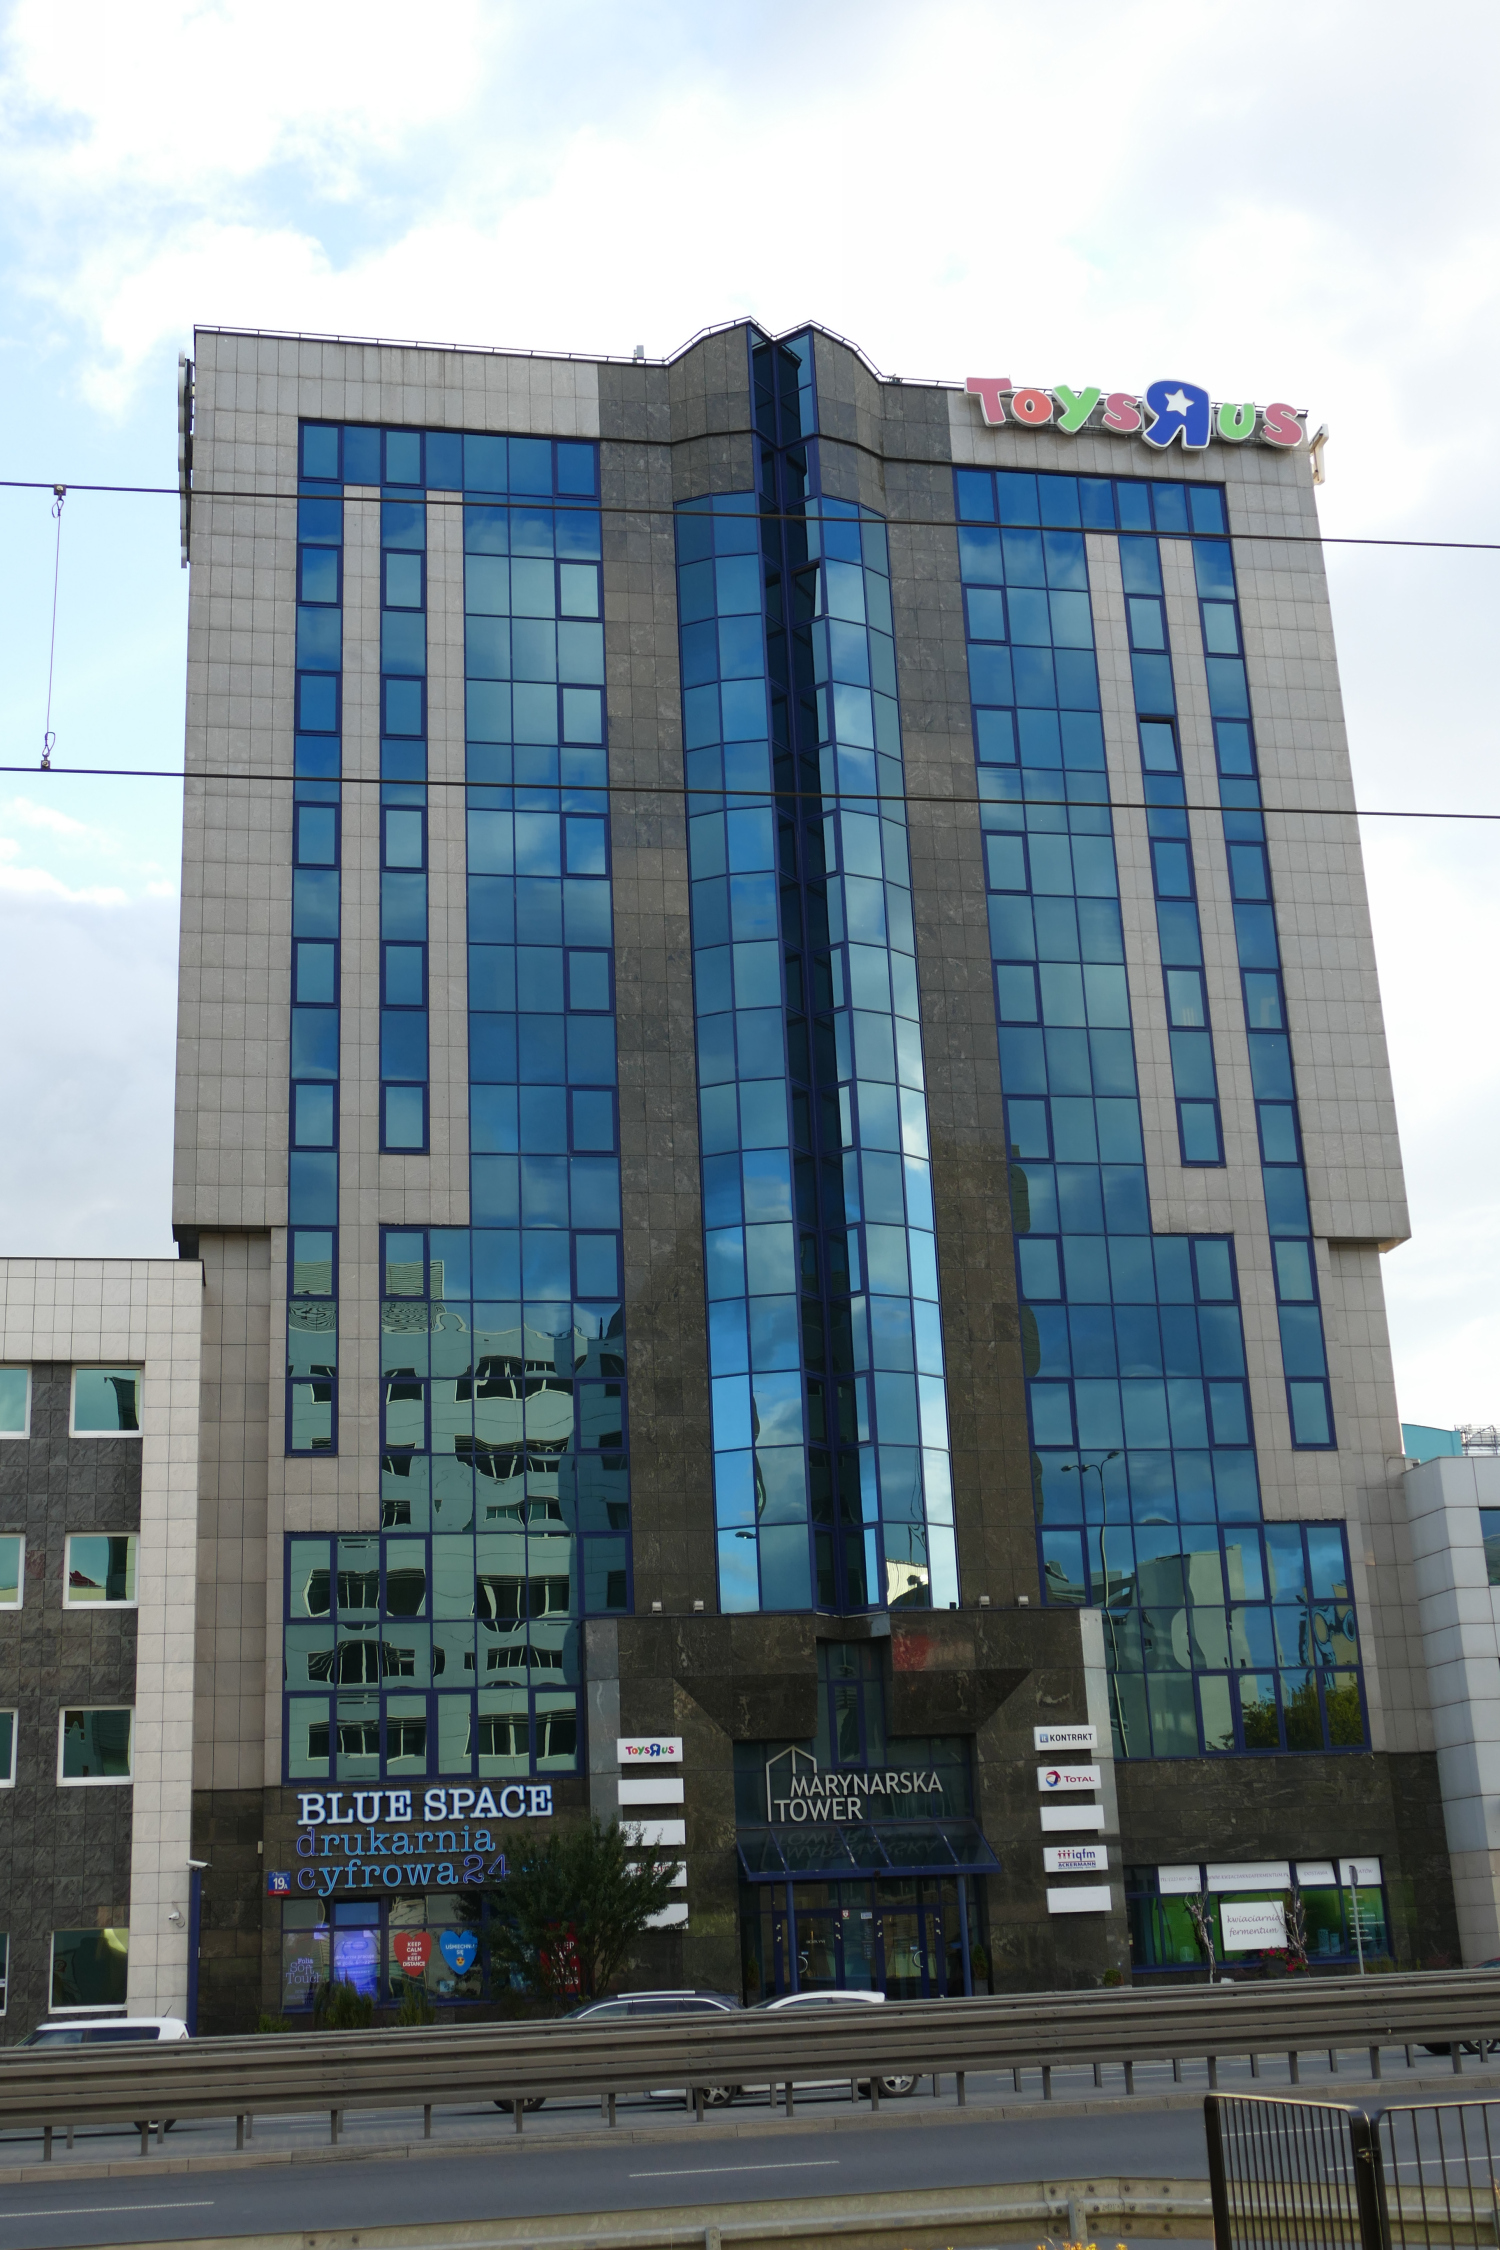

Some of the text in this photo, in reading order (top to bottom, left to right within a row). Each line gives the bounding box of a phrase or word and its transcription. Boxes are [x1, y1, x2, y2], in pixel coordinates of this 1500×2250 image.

[1050, 1733, 1093, 1742] KONTRAKT
[790, 1771, 943, 1797] MARYNARSKA
[297, 1784, 553, 1825] BLUE SPACE
[774, 1797, 864, 1823] TOWER
[296, 1825, 496, 1857] drukarnia
[1226, 1914, 1281, 1924] kwiaciarnia
[1229, 1927, 1278, 1937] fermentum
[290, 1962, 314, 1974] Soft
